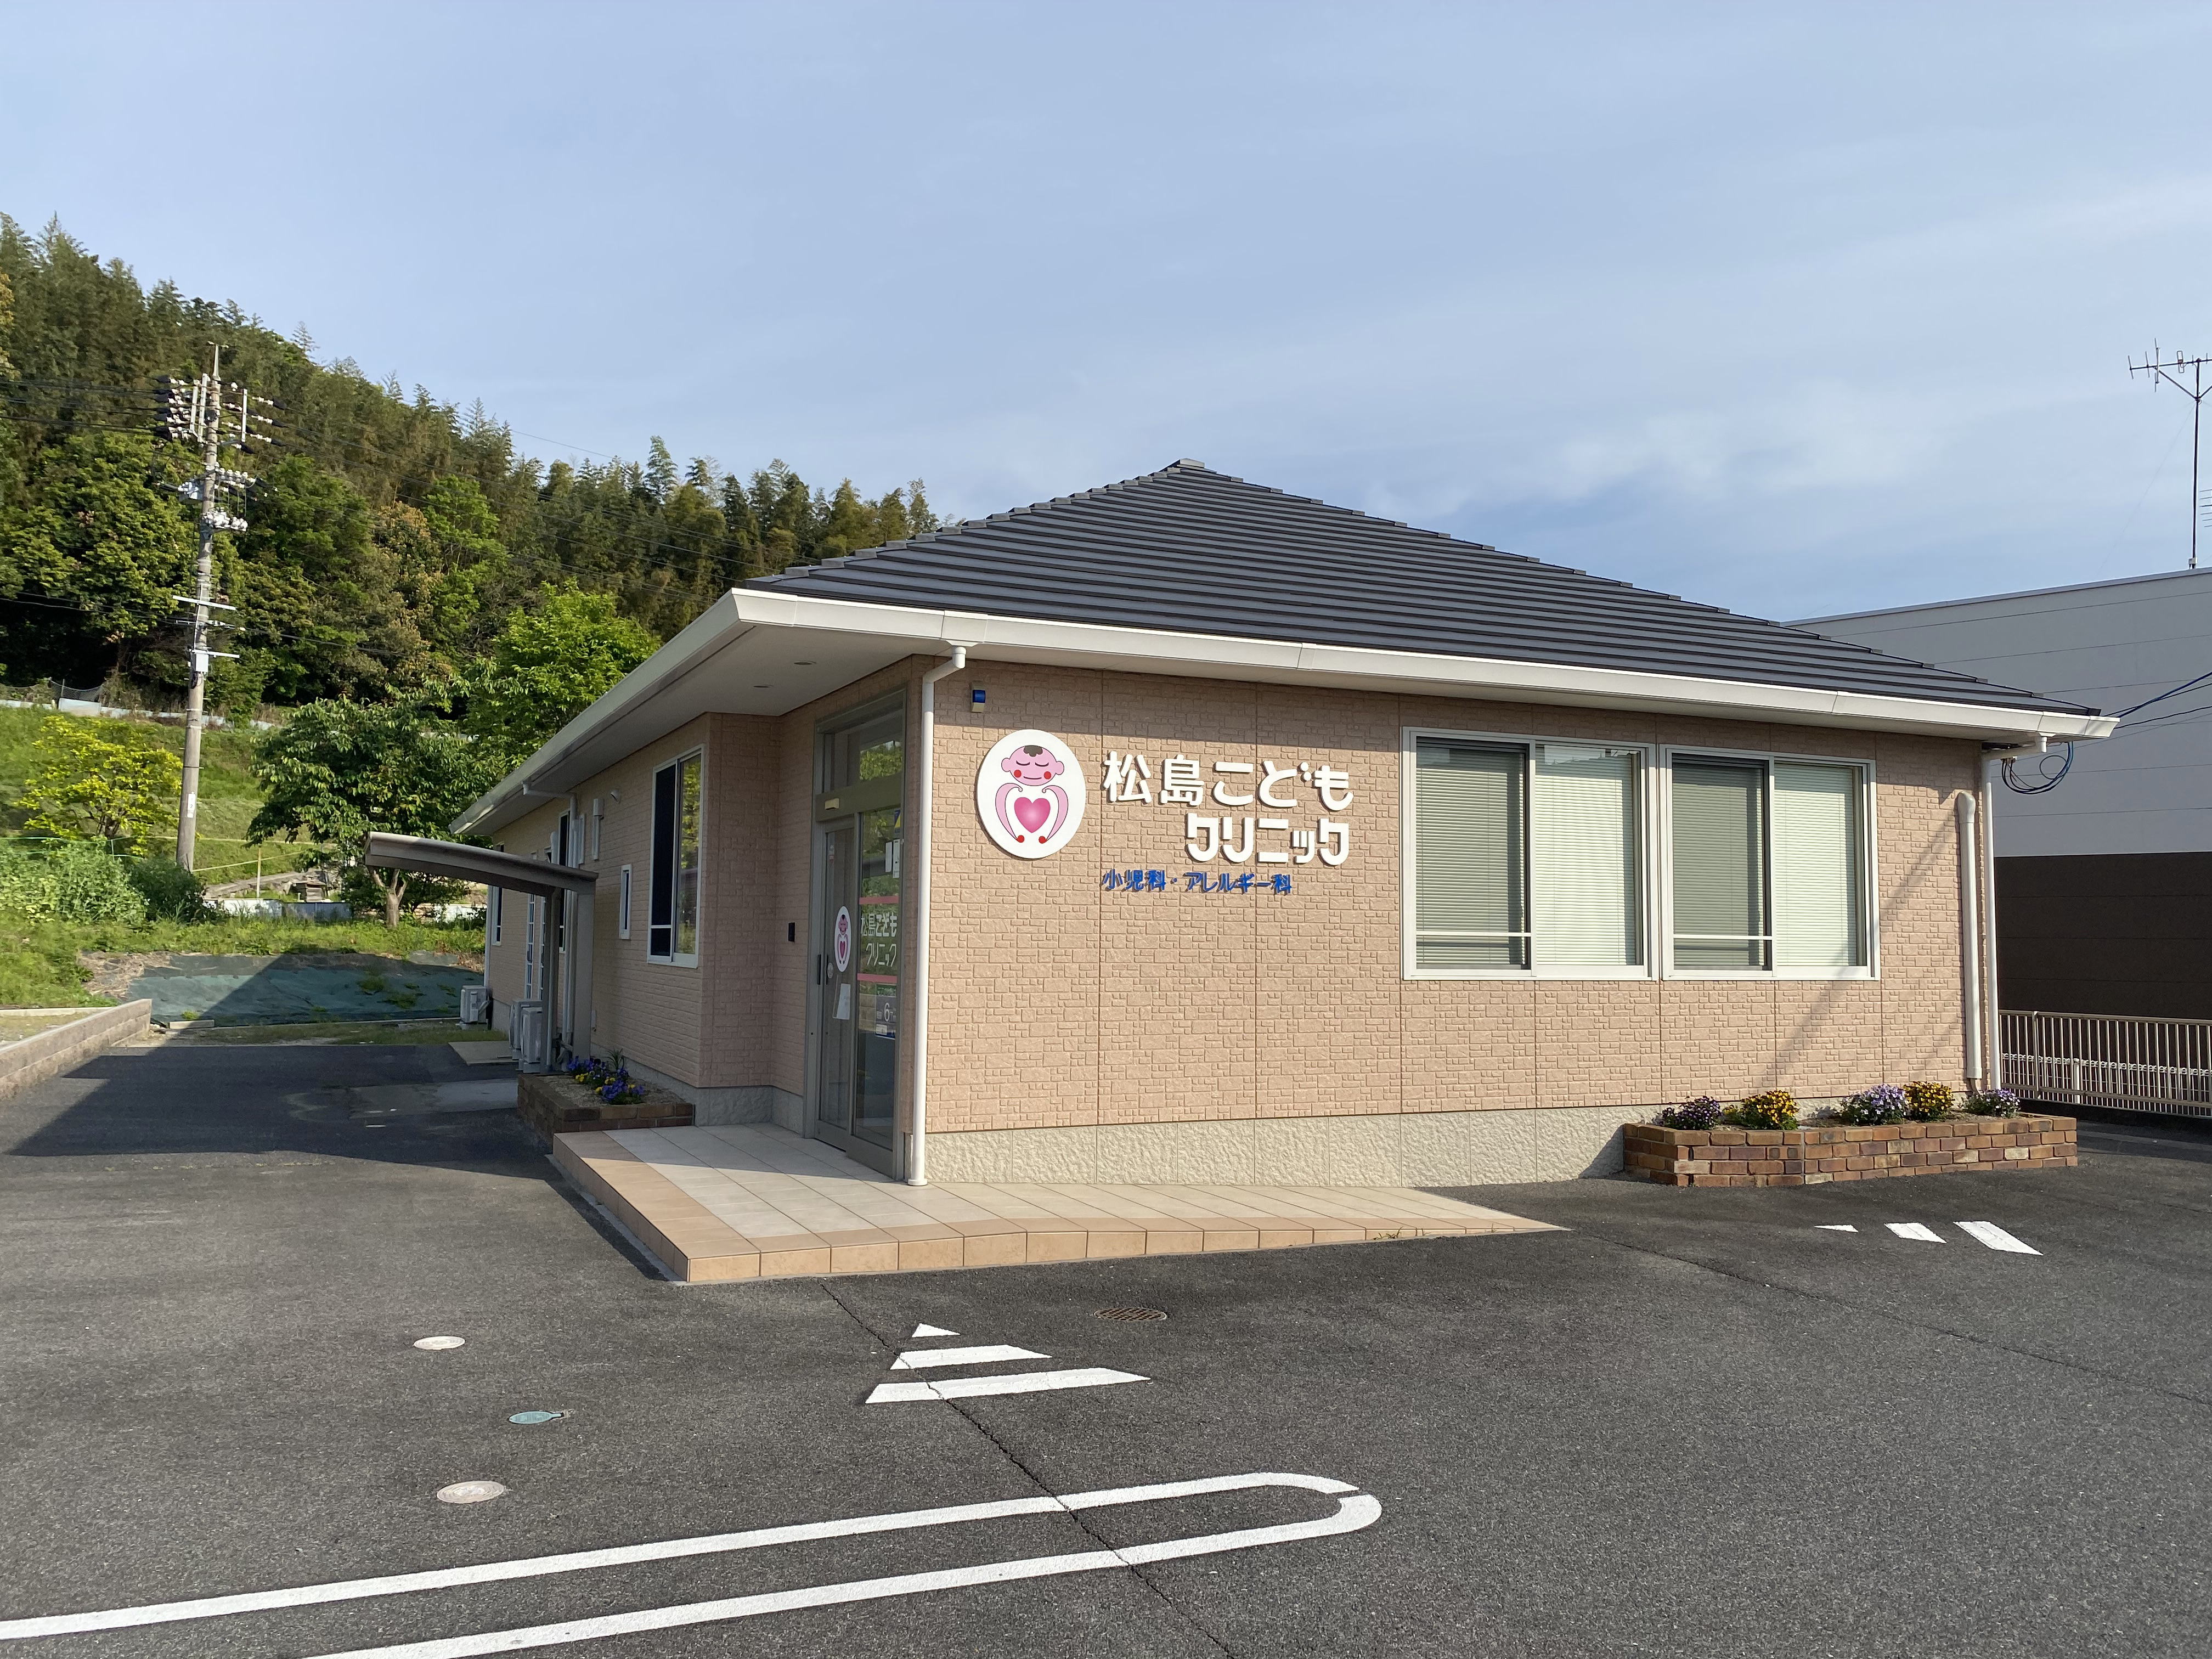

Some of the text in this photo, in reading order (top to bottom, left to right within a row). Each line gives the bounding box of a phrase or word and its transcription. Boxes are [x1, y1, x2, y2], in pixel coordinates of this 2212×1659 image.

[1103, 751, 1354, 811] 松島こども
[1186, 813, 1350, 866] クリニック
[1102, 868, 1292, 894] 小児科・アレルギー科
[861, 912, 898, 937] 松島こども
[866, 942, 896, 967] クリニック
